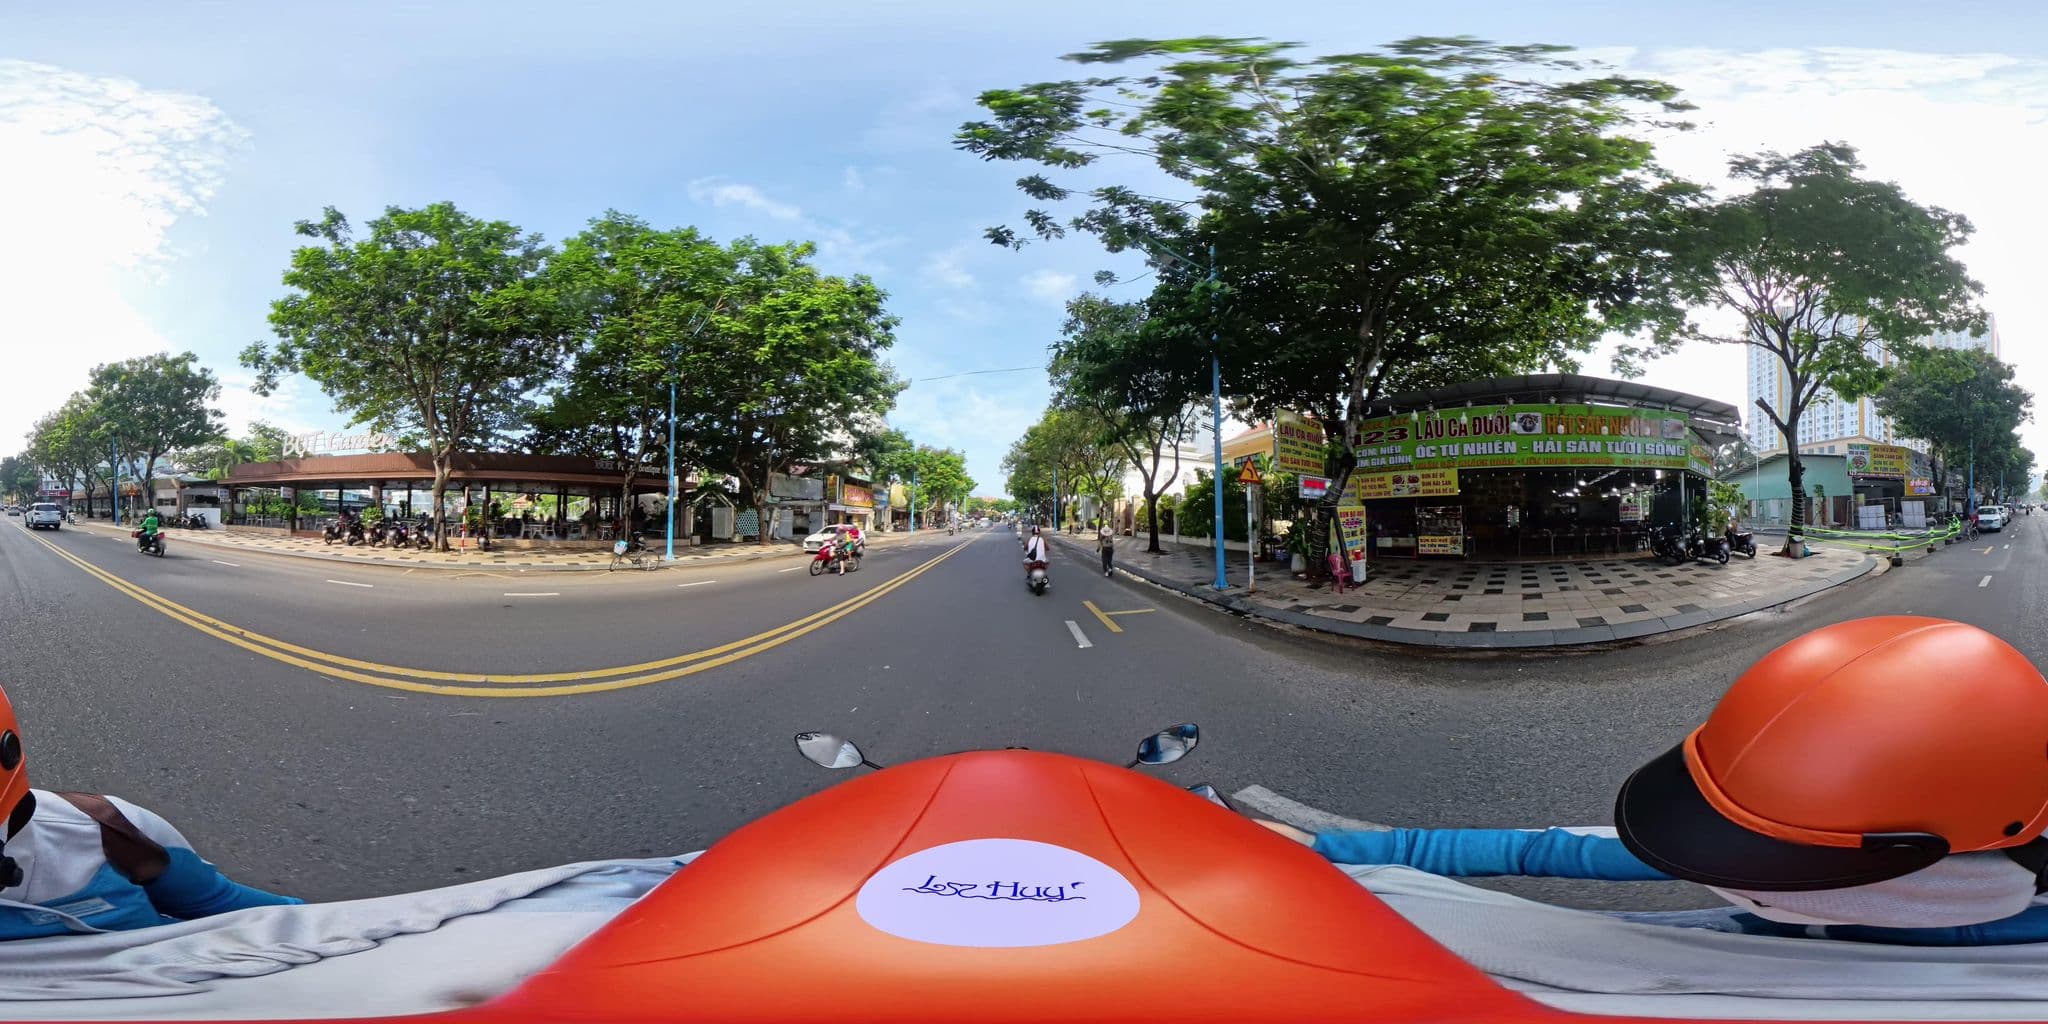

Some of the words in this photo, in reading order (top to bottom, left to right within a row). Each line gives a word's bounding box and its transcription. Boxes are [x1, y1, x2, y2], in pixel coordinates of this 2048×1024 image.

[1415, 443, 1436, 459] ỐC
[1440, 444, 1459, 459] TỰ
[1463, 440, 1517, 455] NHIÊN
[1532, 437, 1562, 453] HẢI
[1566, 437, 1601, 453] SẢN
[1607, 441, 1641, 455] TƯƠI
[1646, 440, 1685, 456] SỐNG
